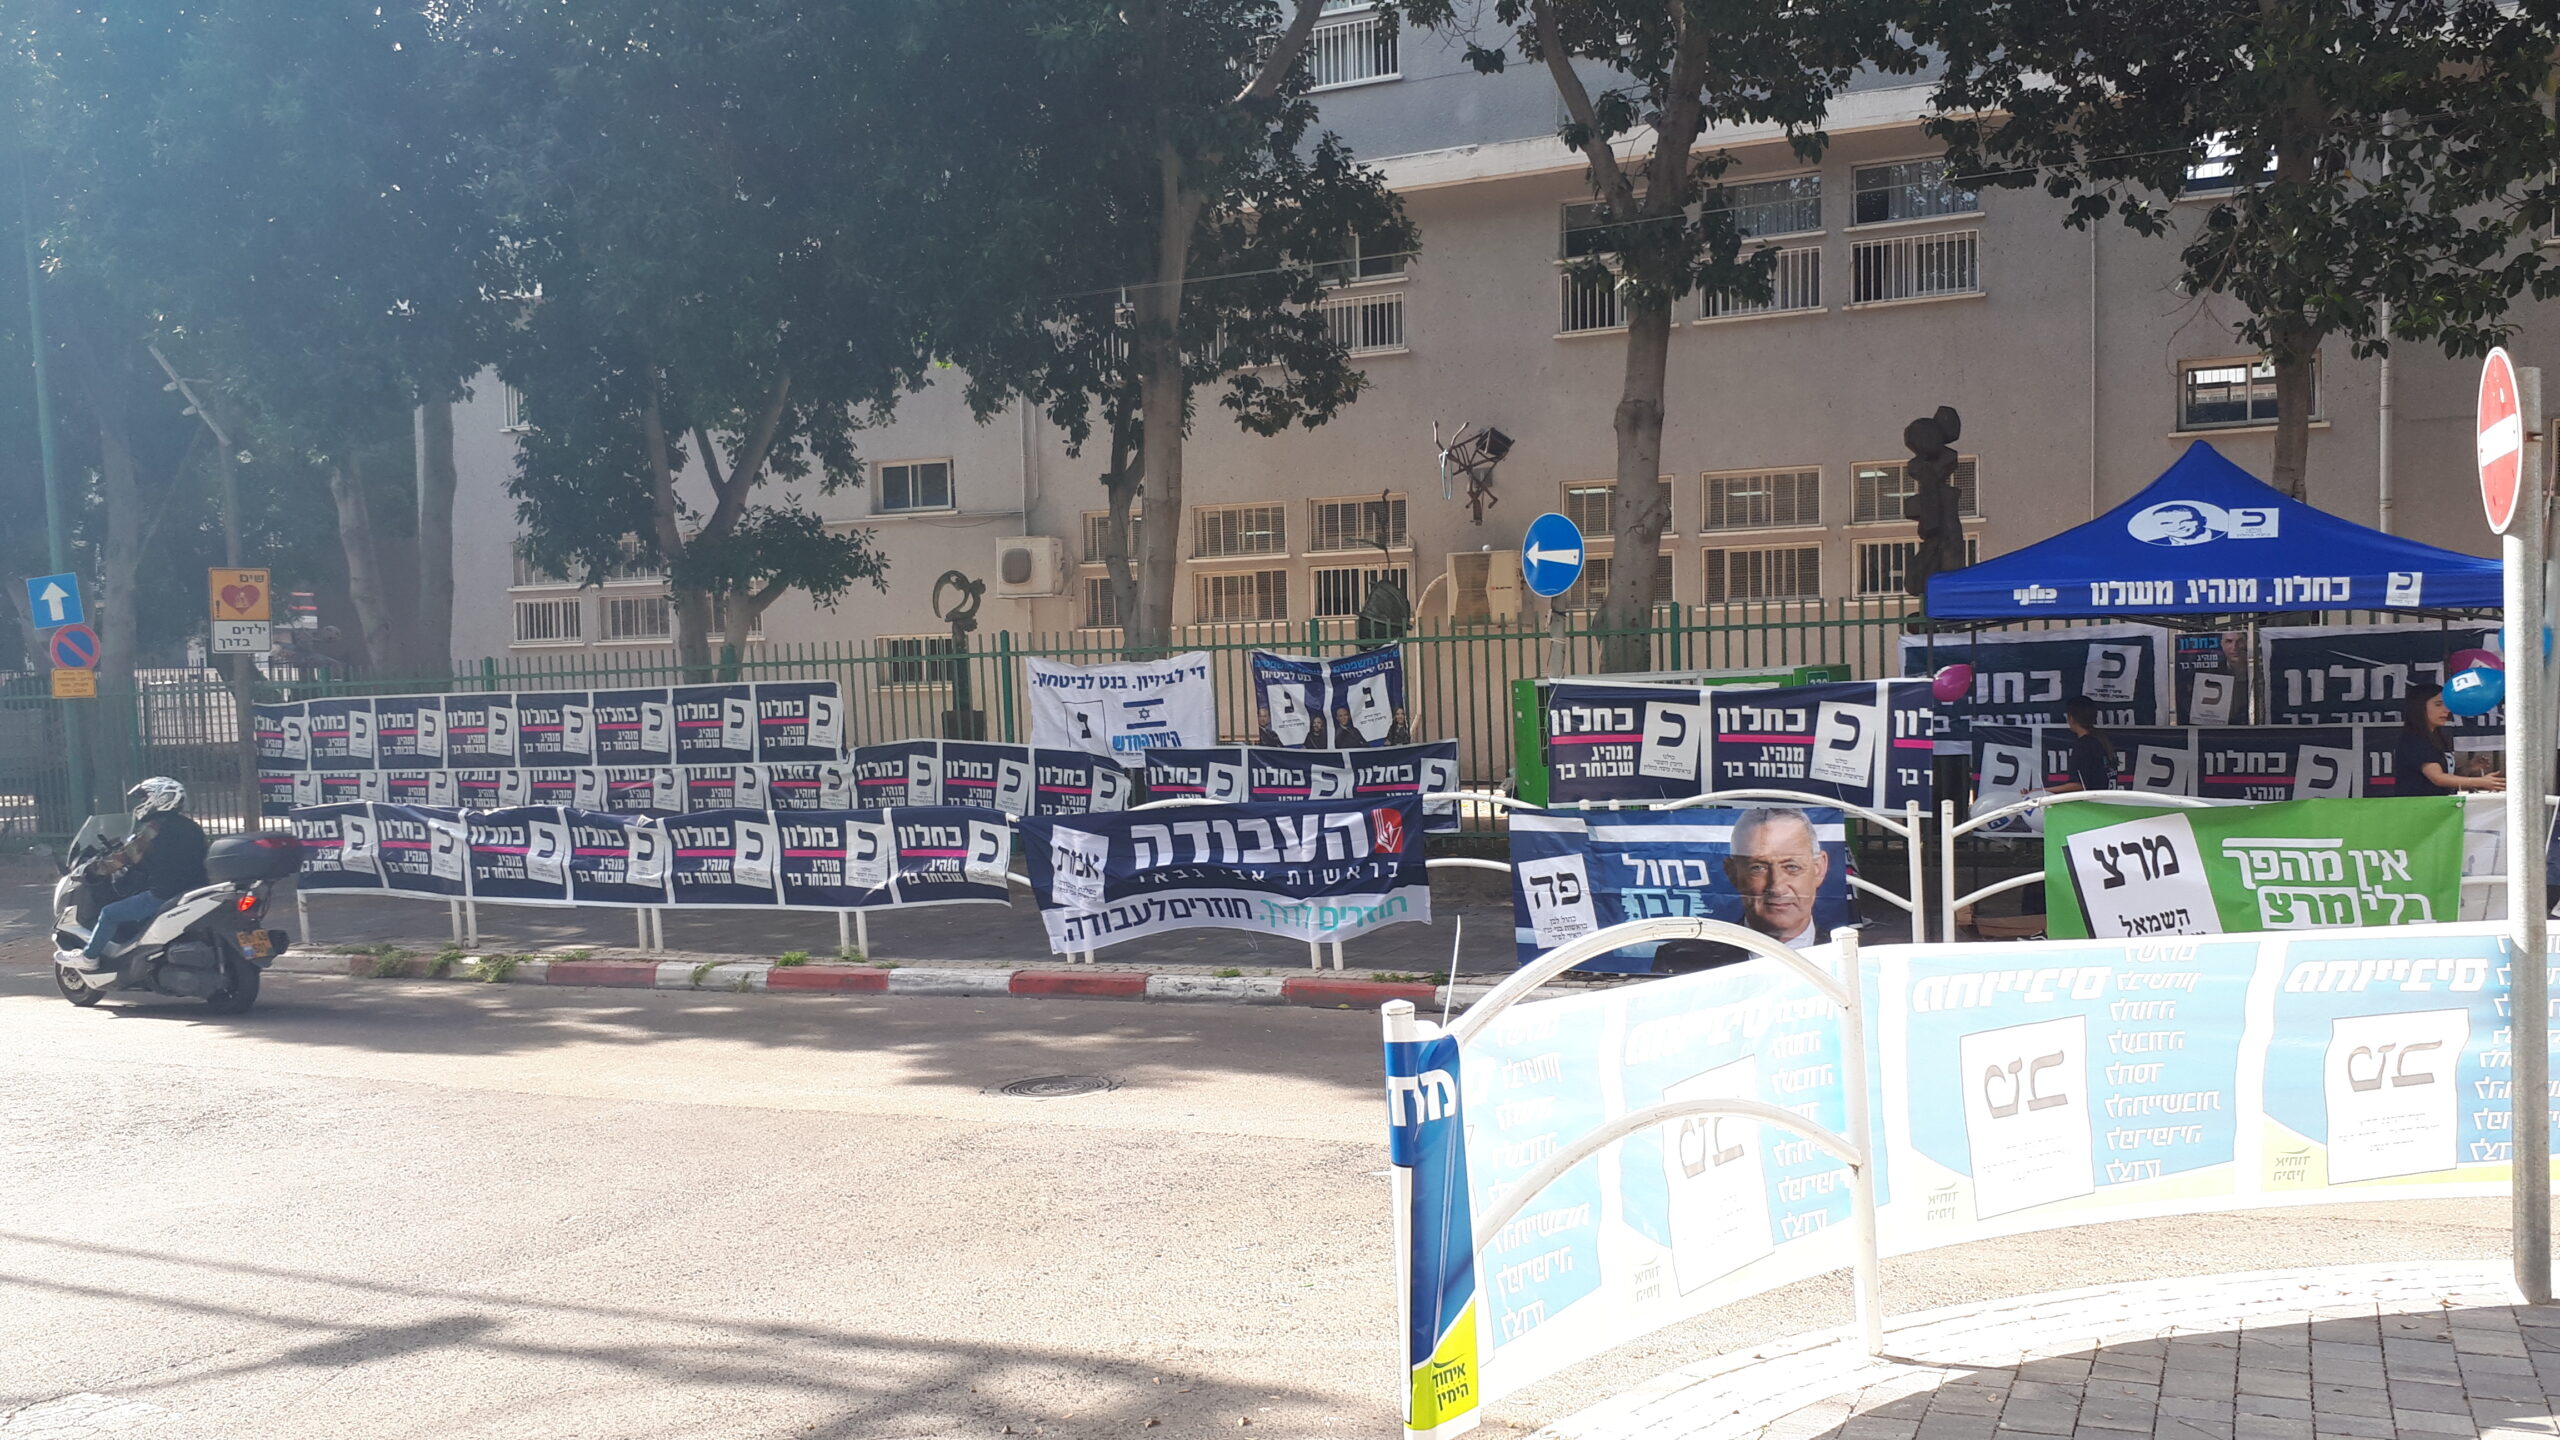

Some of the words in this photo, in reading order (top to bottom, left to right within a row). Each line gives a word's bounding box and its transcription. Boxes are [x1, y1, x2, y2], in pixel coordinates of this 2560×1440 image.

[2241, 511, 2266, 527] כ
[240, 574, 264, 582] שים
[2396, 573, 2413, 590] כ
[2090, 581, 2174, 606] משלנו
[2185, 579, 2257, 603] מנהיג
[2266, 576, 2350, 605] כחלון.
[232, 624, 266, 634] ילדים
[218, 638, 250, 649] בדרך
[1190, 666, 1206, 679] די
[2098, 651, 2126, 679] כ
[1100, 676, 1127, 689] בנט
[2201, 679, 2222, 705] כ
[1284, 691, 1294, 713] נ
[1363, 687, 1374, 708] נ
[448, 710, 485, 727] כחלון
[595, 706, 638, 724] כחלון
[649, 708, 662, 731] כ
[677, 702, 719, 722] כחלון
[730, 704, 744, 728] כ
[760, 700, 804, 719] כחלון
[818, 702, 831, 726] כ
[1718, 705, 1806, 734] כחלון
[356, 718, 367, 738] כ
[378, 712, 414, 729] כחלון
[424, 716, 436, 736] כ
[495, 714, 508, 735] כ
[783, 726, 804, 736] מנהיג
[1077, 712, 1092, 739] נ
[1550, 706, 1634, 735] כחלון
[1656, 709, 1686, 747] כ
[1829, 710, 1861, 751] כ
[693, 738, 720, 748] שבוחר
[698, 728, 720, 738] מנהיג
[764, 737, 776, 747] בך
[776, 736, 804, 746] שבוחר
[680, 739, 692, 749] בך
[1591, 745, 1634, 760] מנהיג
[1760, 746, 1804, 762] מנהיג
[856, 760, 903, 778] כחלון
[946, 759, 993, 779] כחלון
[1556, 764, 1576, 780] בך
[1580, 762, 1634, 777] שבוחר
[1722, 762, 1744, 779] בך
[1748, 762, 1804, 779] שבוחר
[1993, 751, 2019, 786] כ
[2147, 754, 2175, 787] כ
[2204, 749, 2287, 775] כחלון
[2308, 753, 2338, 788] כ
[917, 761, 931, 786] כ
[1004, 766, 1021, 792] כ
[1039, 766, 1086, 786] כחלון
[1150, 765, 1202, 785] כחלון
[1217, 769, 1234, 796] כ
[1252, 766, 1305, 787] כחלון
[1357, 764, 1413, 785] כחלון
[1429, 765, 1447, 792] כ
[882, 786, 904, 797] מנהיג
[968, 788, 992, 798] מנהיג
[1100, 772, 1116, 798] כ
[1320, 771, 1339, 798] כ
[1062, 794, 1086, 806] מנהיג
[352, 822, 367, 848] כ
[379, 819, 426, 840] כחלון
[471, 826, 525, 846] כחלון
[572, 826, 624, 847] כחלון
[671, 826, 730, 849] כחלון
[782, 824, 838, 848] כחלון
[898, 824, 962, 849] כחלון
[538, 829, 557, 858] כ
[637, 832, 655, 861] כ
[745, 830, 763, 862] כ
[857, 830, 877, 861] כ
[978, 830, 999, 862] כ
[1130, 812, 1369, 869] העבודה
[404, 850, 428, 863] מנהיג
[498, 855, 523, 867] מנהיג
[600, 858, 625, 870] מנהיג
[703, 859, 729, 872] מנהיג
[812, 859, 840, 872] מנהיג
[929, 858, 959, 873] מנהיג
[1057, 846, 1100, 880] אמת
[2093, 834, 2181, 890] מרצ
[386, 862, 399, 874] בך
[398, 862, 429, 875] שבוחר
[477, 866, 490, 880] בך
[492, 866, 525, 879] שבוחר
[576, 870, 591, 883] בך
[592, 870, 624, 884] שבוחר
[696, 872, 731, 885] שבוחר
[1286, 862, 1399, 885] בראשות
[1621, 853, 1710, 887] כחול
[2223, 849, 2344, 891] מהפך
[2349, 849, 2412, 891] אין
[677, 872, 692, 886] בך
[787, 873, 801, 887] בך
[805, 873, 841, 886] שבוחר
[1529, 872, 1581, 909] פה
[1171, 897, 1253, 919] חוזרים
[1259, 899, 1313, 928] לדרך.
[1319, 895, 1407, 931] חוזרים
[1634, 888, 1690, 919] לבן
[2264, 890, 2356, 925] מרצ
[2361, 887, 2438, 926] בלי
[1064, 898, 1168, 943] לעבודה.
[2118, 908, 2190, 937] השמאל
[1436, 1381, 1470, 1411] הימין
